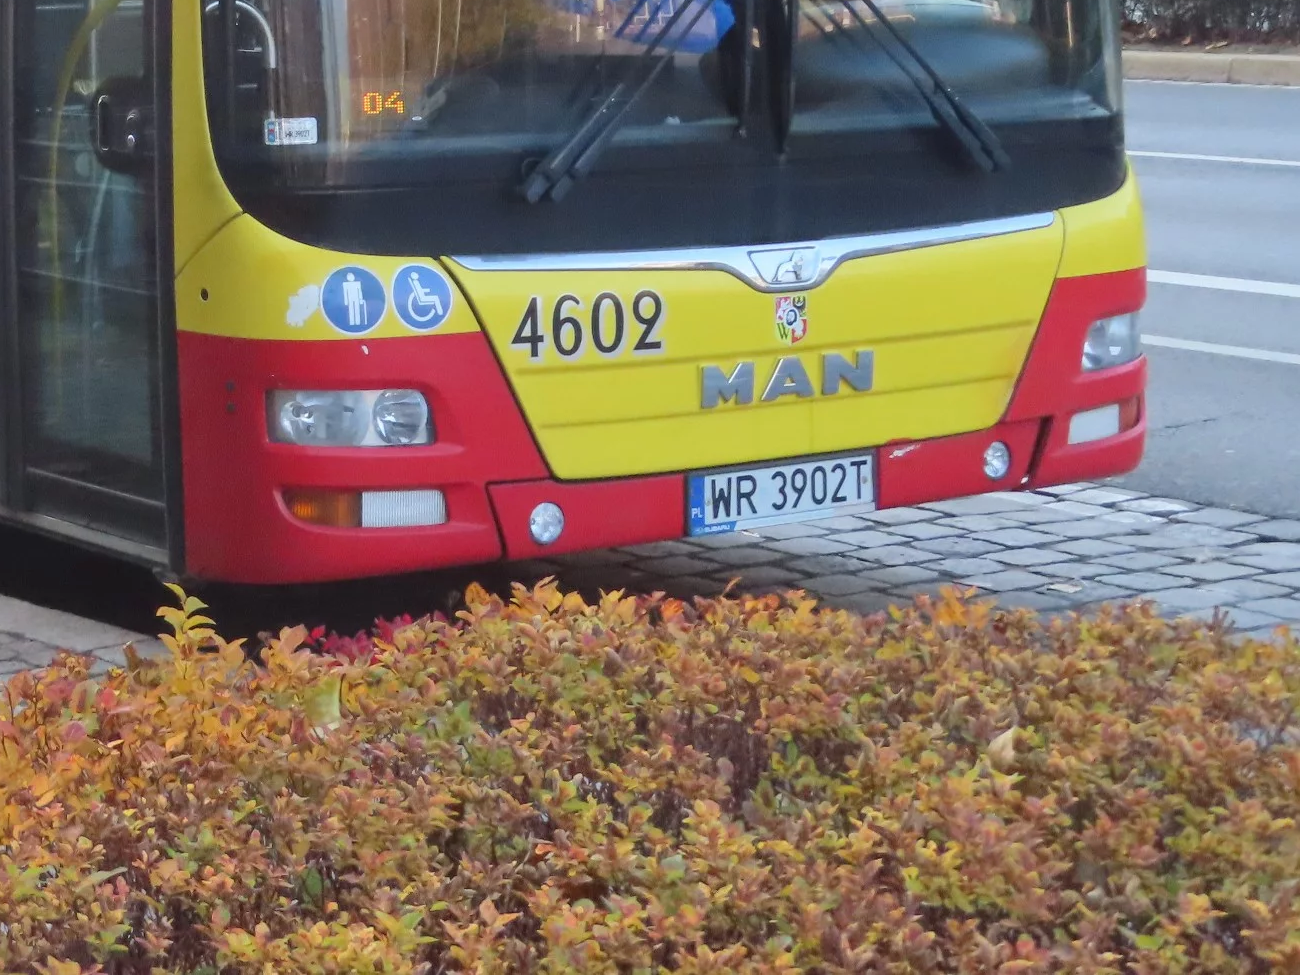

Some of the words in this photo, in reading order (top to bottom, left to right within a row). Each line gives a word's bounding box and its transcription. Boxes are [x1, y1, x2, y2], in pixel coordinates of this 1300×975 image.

[362, 91, 405, 115] 04
[511, 289, 663, 358] 4602
[699, 350, 875, 410] MAN
[691, 507, 703, 519] PL
[711, 475, 758, 520] WR
[771, 460, 868, 511] 3902T
